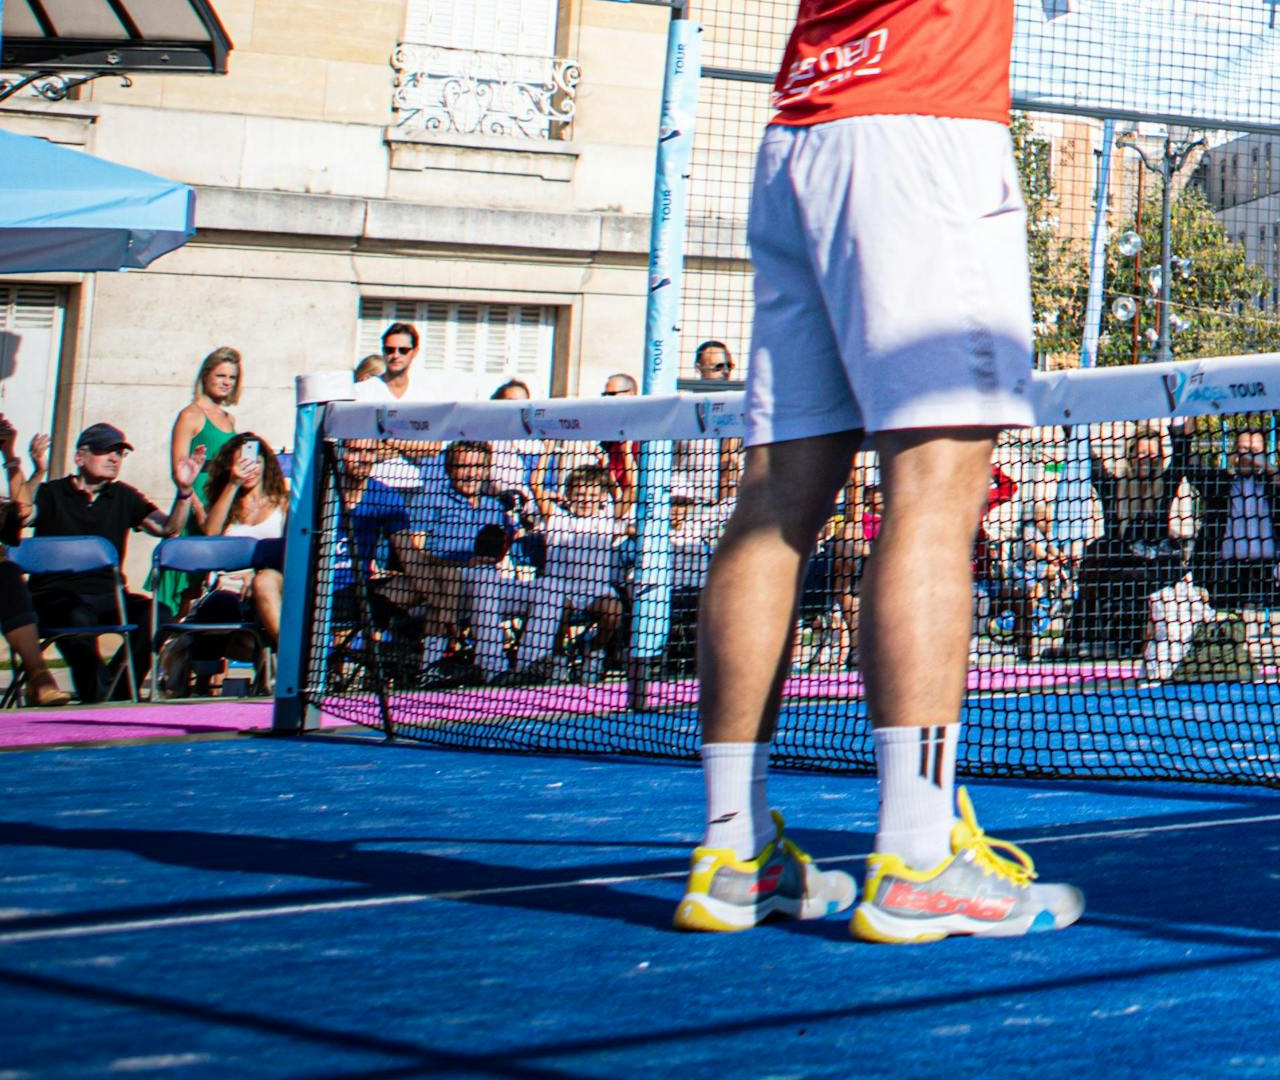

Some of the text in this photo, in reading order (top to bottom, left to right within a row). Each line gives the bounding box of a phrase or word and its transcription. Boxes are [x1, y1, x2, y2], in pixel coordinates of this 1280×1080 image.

[674, 43, 687, 75] TOUR
[661, 189, 672, 222] TOUR
[653, 339, 664, 373] TOUR
[1229, 381, 1266, 399] TOUR
[409, 420, 430, 431] TOUR
[558, 419, 581, 430] TOUR
